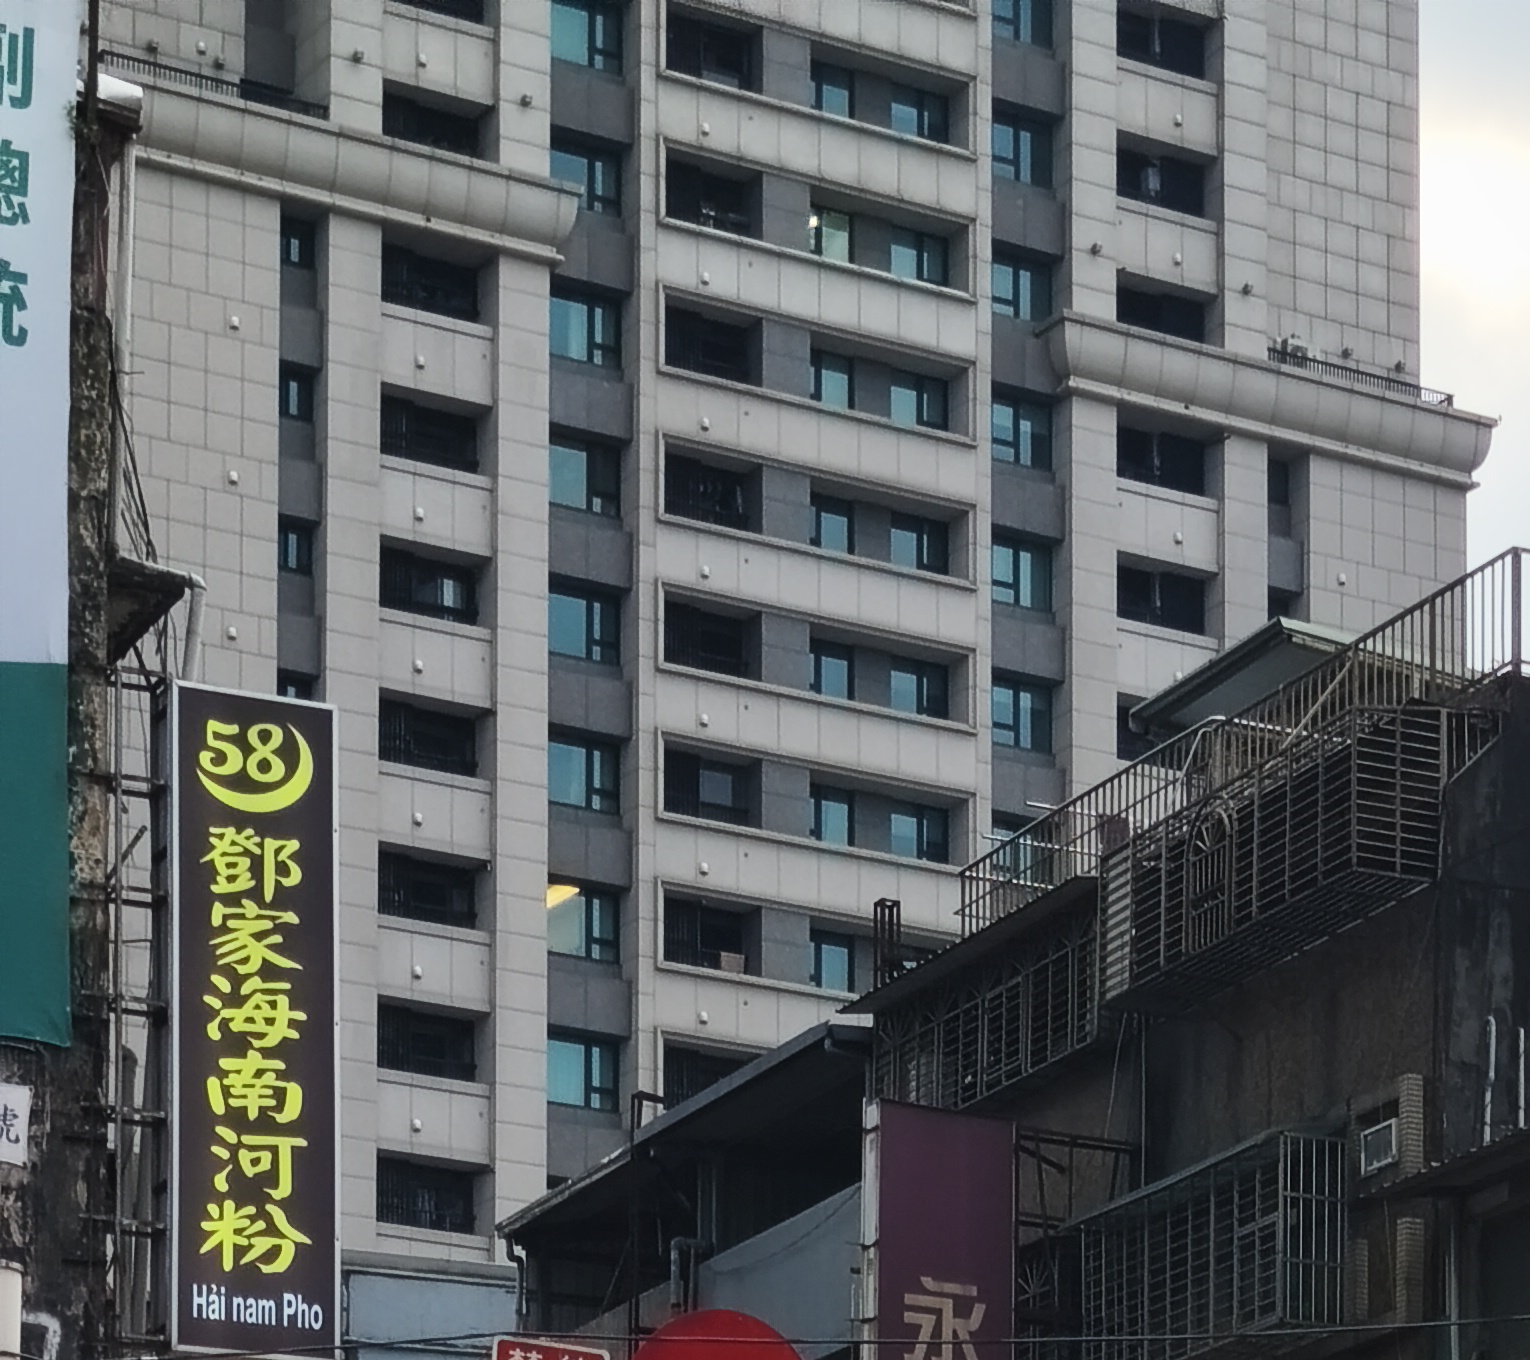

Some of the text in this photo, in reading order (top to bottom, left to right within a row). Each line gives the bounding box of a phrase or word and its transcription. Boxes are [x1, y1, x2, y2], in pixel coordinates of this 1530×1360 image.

[198, 718, 286, 784] 58
[198, 826, 313, 1274] 鄧家海南河粉
[233, 1296, 277, 1327] nam
[282, 1292, 324, 1331] Pho
